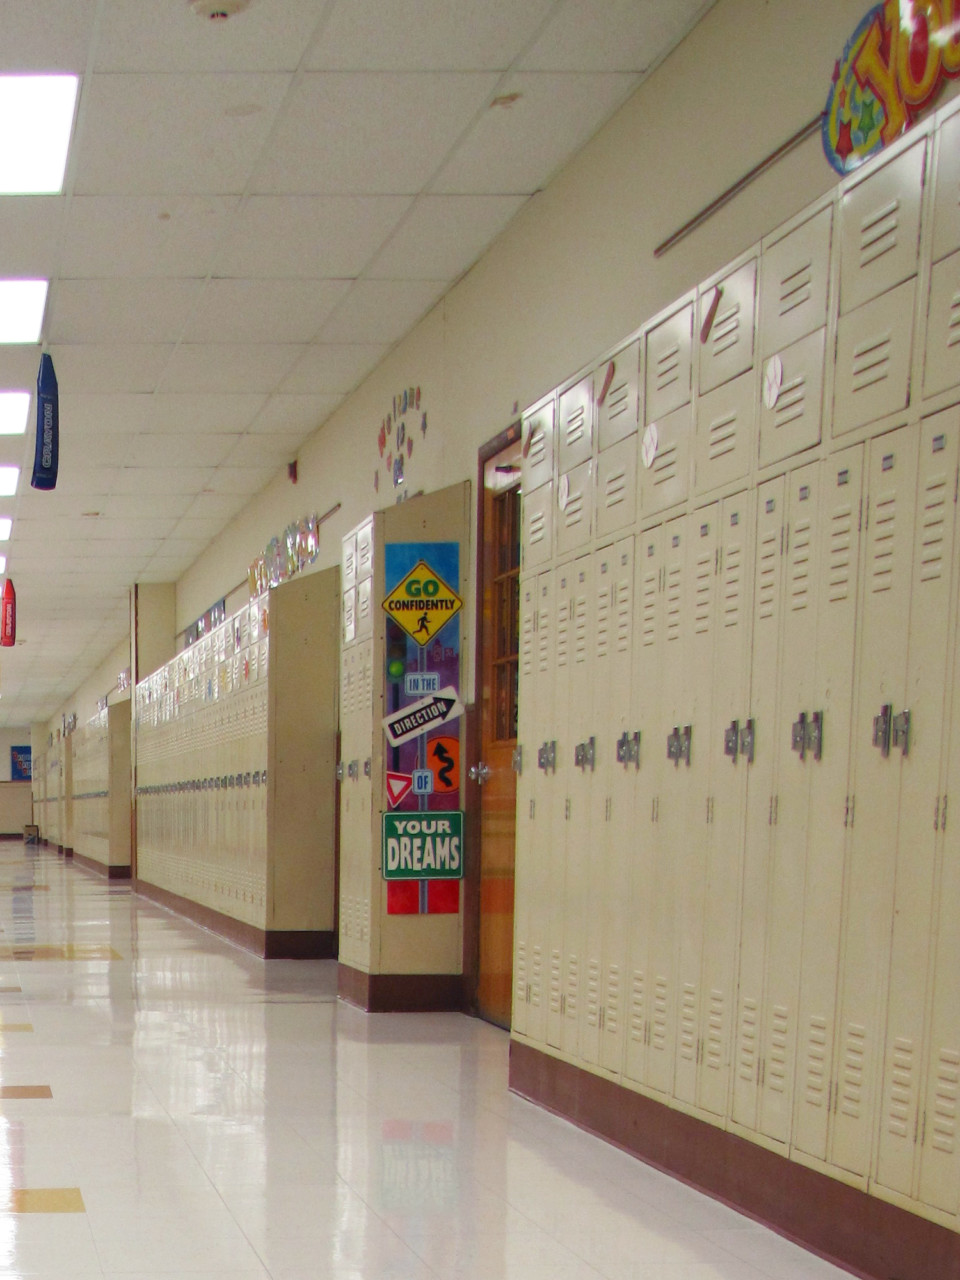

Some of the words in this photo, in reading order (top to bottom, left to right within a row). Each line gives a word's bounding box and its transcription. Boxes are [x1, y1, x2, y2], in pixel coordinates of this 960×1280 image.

[41, 402, 53, 469] CRAYON
[404, 578, 440, 598] GO
[387, 598, 456, 612] CONFIDENTLY
[408, 677, 420, 692] IN
[421, 677, 437, 691] THE
[392, 700, 448, 736] DIRECTION
[416, 774, 429, 791] OF
[393, 820, 452, 835] YOUR
[386, 835, 460, 871] DREAMS
